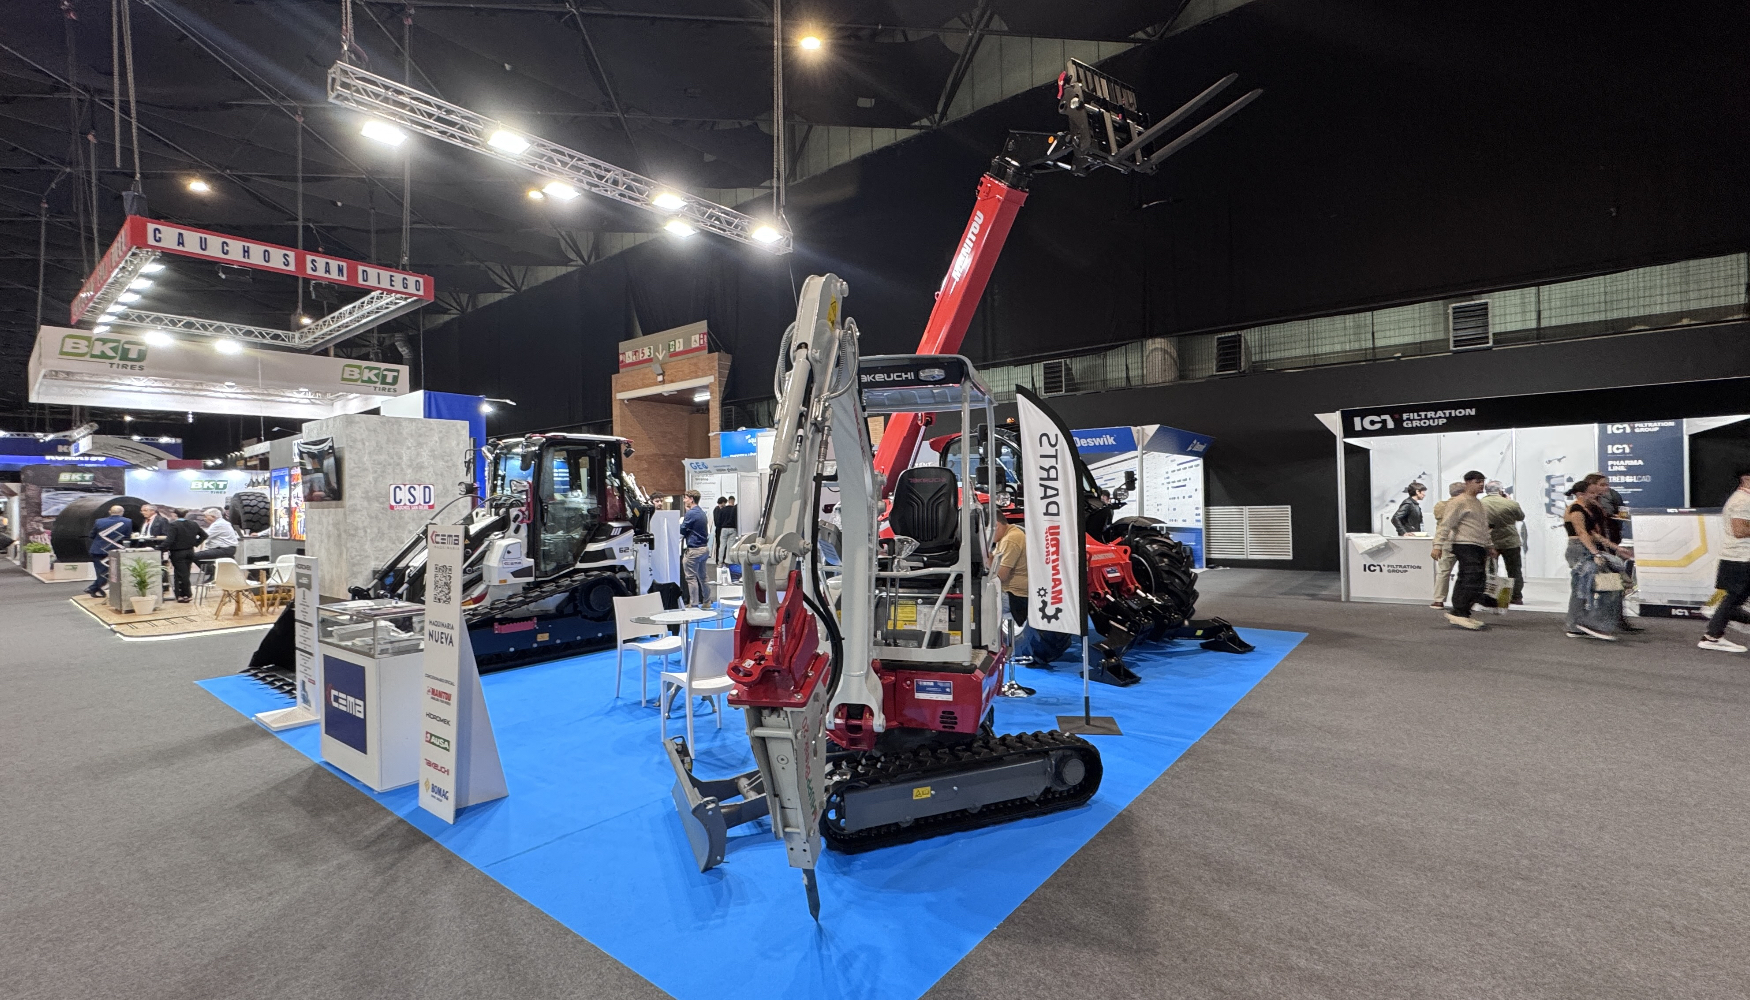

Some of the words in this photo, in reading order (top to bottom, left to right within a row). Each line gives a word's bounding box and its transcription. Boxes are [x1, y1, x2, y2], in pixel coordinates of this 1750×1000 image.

[153, 227, 290, 267] CAUCHOS
[310, 258, 345, 278] SAN
[361, 269, 421, 292] DIEGO
[62, 337, 146, 359] BKT
[109, 362, 145, 371] TIRES
[343, 366, 398, 383] BKT
[860, 372, 915, 383] AKEUCHI
[1402, 408, 1476, 420] FILTRATION
[1402, 418, 1447, 428] GROUP
[1073, 434, 1117, 447] Deswik
[60, 473, 93, 482] BKT
[191, 479, 228, 491] BKT
[393, 485, 432, 505] CSD
[428, 618, 455, 630] MAQUINARIA
[428, 629, 455, 647] NUEVA
[331, 688, 365, 719] CEMA
